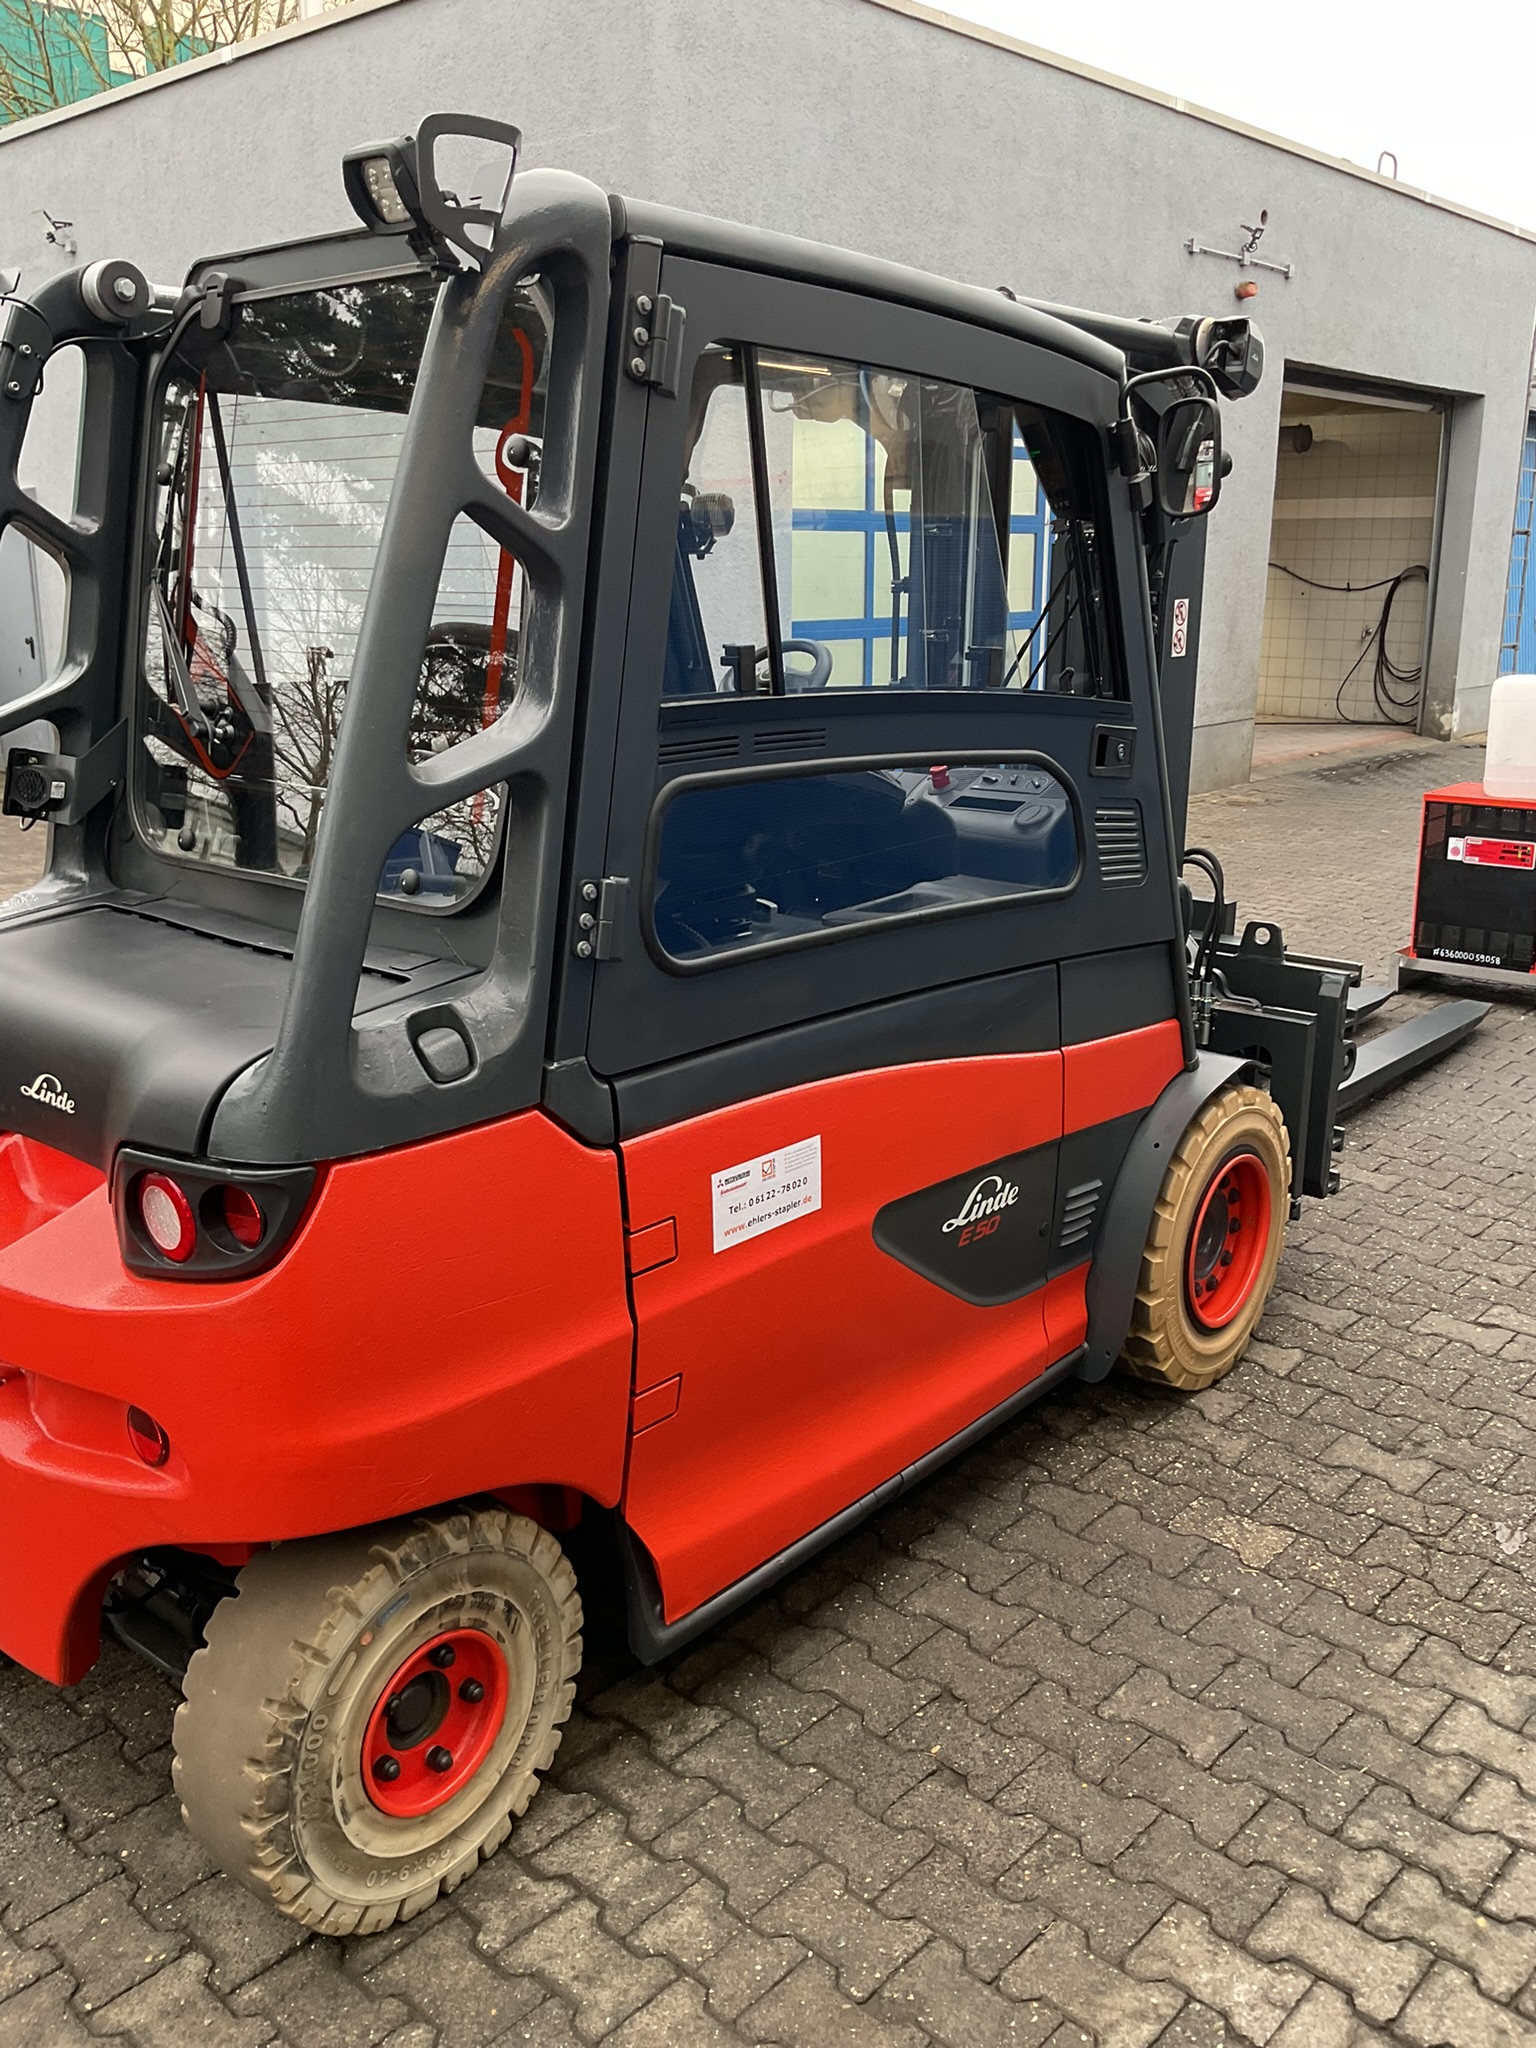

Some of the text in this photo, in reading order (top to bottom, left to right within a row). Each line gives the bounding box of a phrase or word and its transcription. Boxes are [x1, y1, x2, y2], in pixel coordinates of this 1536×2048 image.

[20, 1073, 76, 1115] Linde
[723, 1195, 813, 1237] www.ehlers-stapler.de
[942, 1175, 1019, 1233] Linde
[510, 1588, 552, 1767] TRELLEBORG
